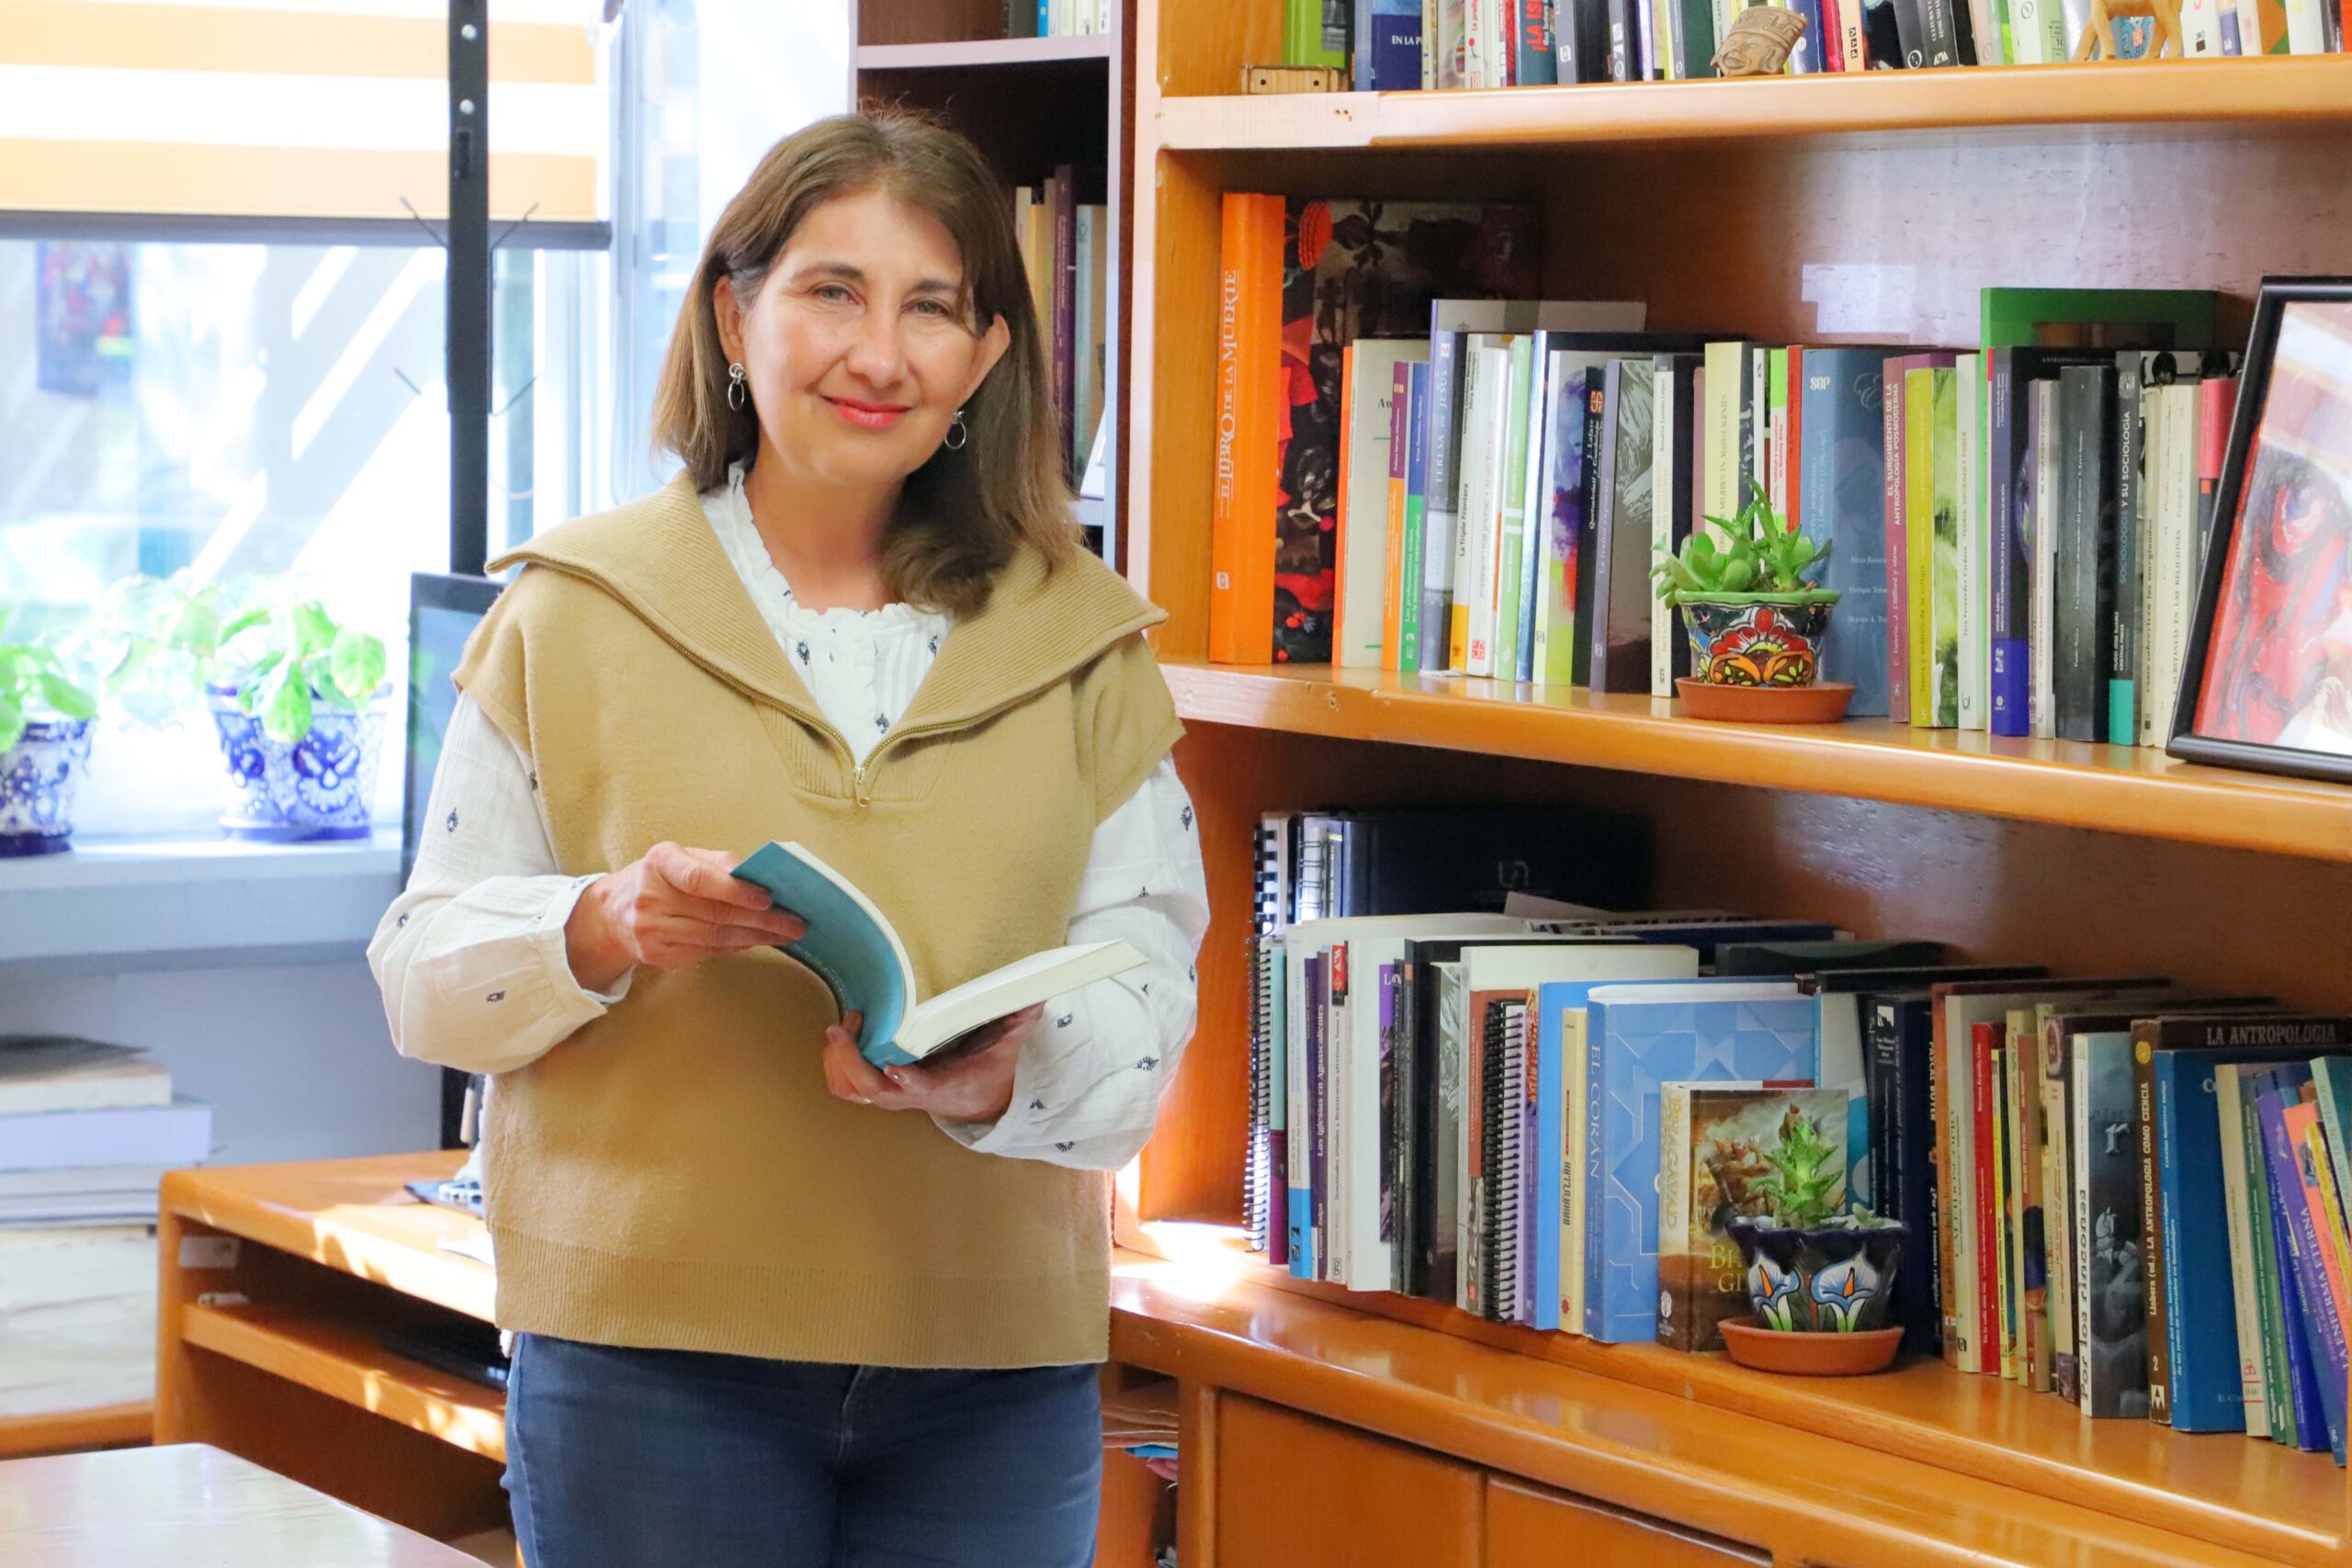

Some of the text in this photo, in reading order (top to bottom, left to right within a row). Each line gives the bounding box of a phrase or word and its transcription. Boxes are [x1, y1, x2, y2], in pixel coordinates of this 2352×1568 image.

[1928, 11, 1937, 41] CULTURA
[1392, 35, 1414, 45] EN LA
[1218, 270, 1238, 498] EL LIBRO DE LA MUERTE
[1885, 384, 1894, 496] EL SURGIMIENTO DE LA
[2121, 411, 2131, 480] SOCIOLOGÍA
[1435, 434, 1445, 483] TERESA
[1587, 451, 1593, 459] J.
[1720, 461, 1726, 471] EN
[1893, 453, 1901, 525] ANTROPOLOGÍA
[2121, 484, 2129, 498] SU
[1460, 547, 1465, 557] La
[1600, 561, 1605, 574] La
[1920, 609, 1926, 619] de
[2174, 611, 2179, 625] EN
[1894, 657, 1899, 665] C.
[1317, 1005, 1325, 1080] Aguascalientes
[2206, 1024, 2337, 1045] LA ANTROPOLOGIA
[1590, 1044, 1600, 1075] EL
[1318, 1082, 1324, 1096] en
[1317, 1098, 1325, 1135] iglesias
[1590, 1082, 1601, 1179] CORÁN
[2318, 1085, 2352, 1203] OCCIDENTE DE MÉXICO
[1666, 1096, 1682, 1230] BHAGAVAD
[1951, 1111, 1959, 1258] CALEIDOSCOPIO
[1929, 1188, 1938, 1208] ¿Por
[2141, 1082, 2157, 1316] Llobera (ed.): LA ANTROPOLOGIA COMO CIENCIA
[1930, 1211, 1939, 1226] qué
[2173, 1267, 2177, 1277] en
[2293, 1258, 2301, 1271] Le
[2077, 1190, 2089, 1401] Por los rincones
[2237, 1264, 2245, 1304] CULTURAS
[2296, 1273, 2310, 1315] Jacques
[2301, 1206, 2349, 1369] LA ENFERMA ETERNA
[2175, 1318, 2180, 1328] de
[1983, 1335, 1988, 1344] En
[2153, 1355, 2159, 1371] 2
[2170, 1341, 2178, 1403] Congregaciones
[2177, 1366, 2183, 1376] de
[2267, 1359, 2272, 1367] la
[2268, 1388, 2277, 1423] Religión
